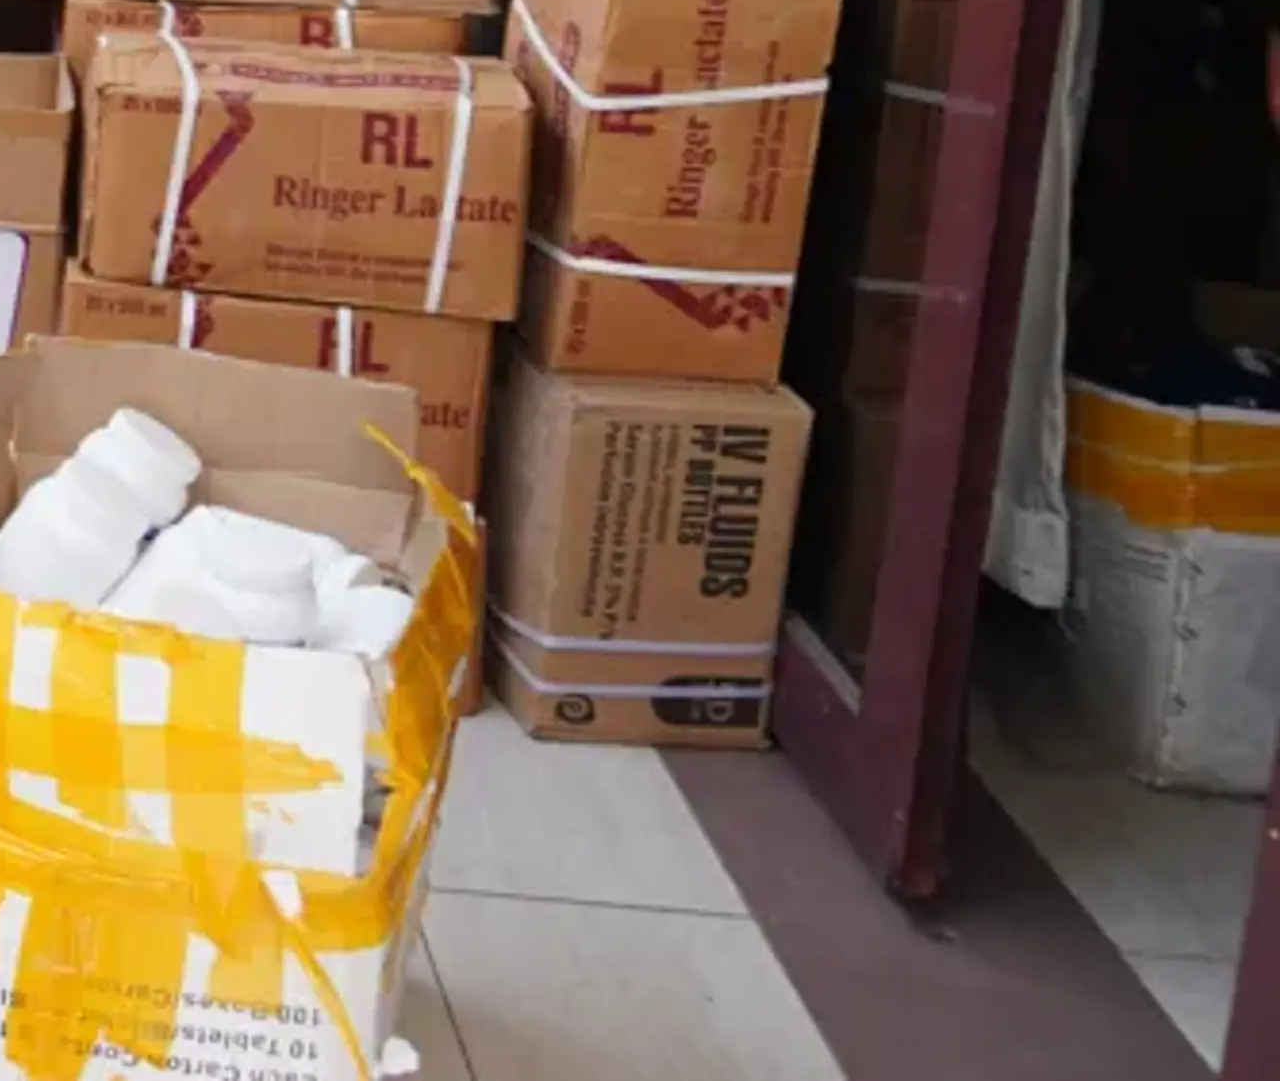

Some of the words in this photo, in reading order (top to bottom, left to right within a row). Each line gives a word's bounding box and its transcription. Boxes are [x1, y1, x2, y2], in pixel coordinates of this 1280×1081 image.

[361, 111, 434, 170] RL
[664, 114, 717, 219] Ringer
[273, 174, 386, 220] Ringer
[392, 183, 519, 225] Latate
[689, 423, 719, 453] PP
[719, 424, 771, 464] IV
[676, 458, 715, 546] BOTTLES
[698, 475, 765, 599] FLUIDS
[288, 1039, 320, 1061] 10
